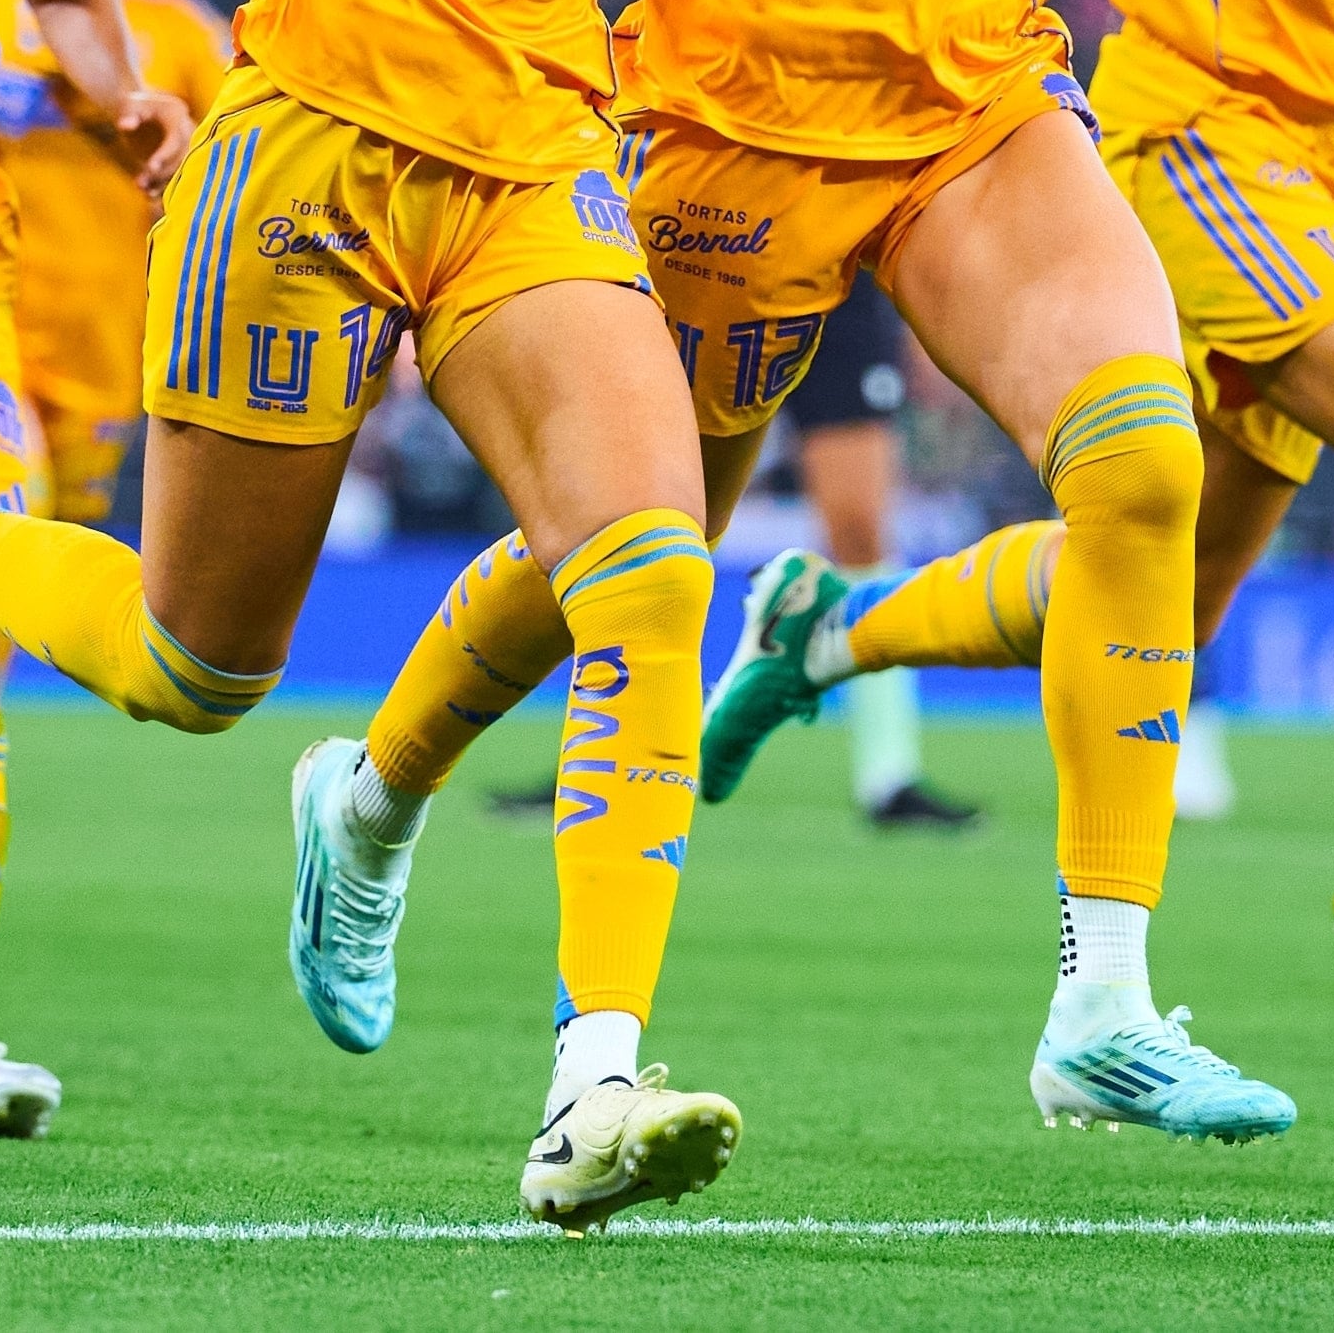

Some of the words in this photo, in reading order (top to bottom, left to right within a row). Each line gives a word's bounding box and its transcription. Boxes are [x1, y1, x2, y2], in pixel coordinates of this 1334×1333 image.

[291, 199, 351, 225] TORTAS
[677, 199, 746, 225] TORTAS
[648, 215, 772, 254] Bernal
[274, 264, 324, 277] DESDE
[665, 258, 711, 280] DESDE
[717, 271, 746, 287] 1960
[727, 313, 821, 408] 12
